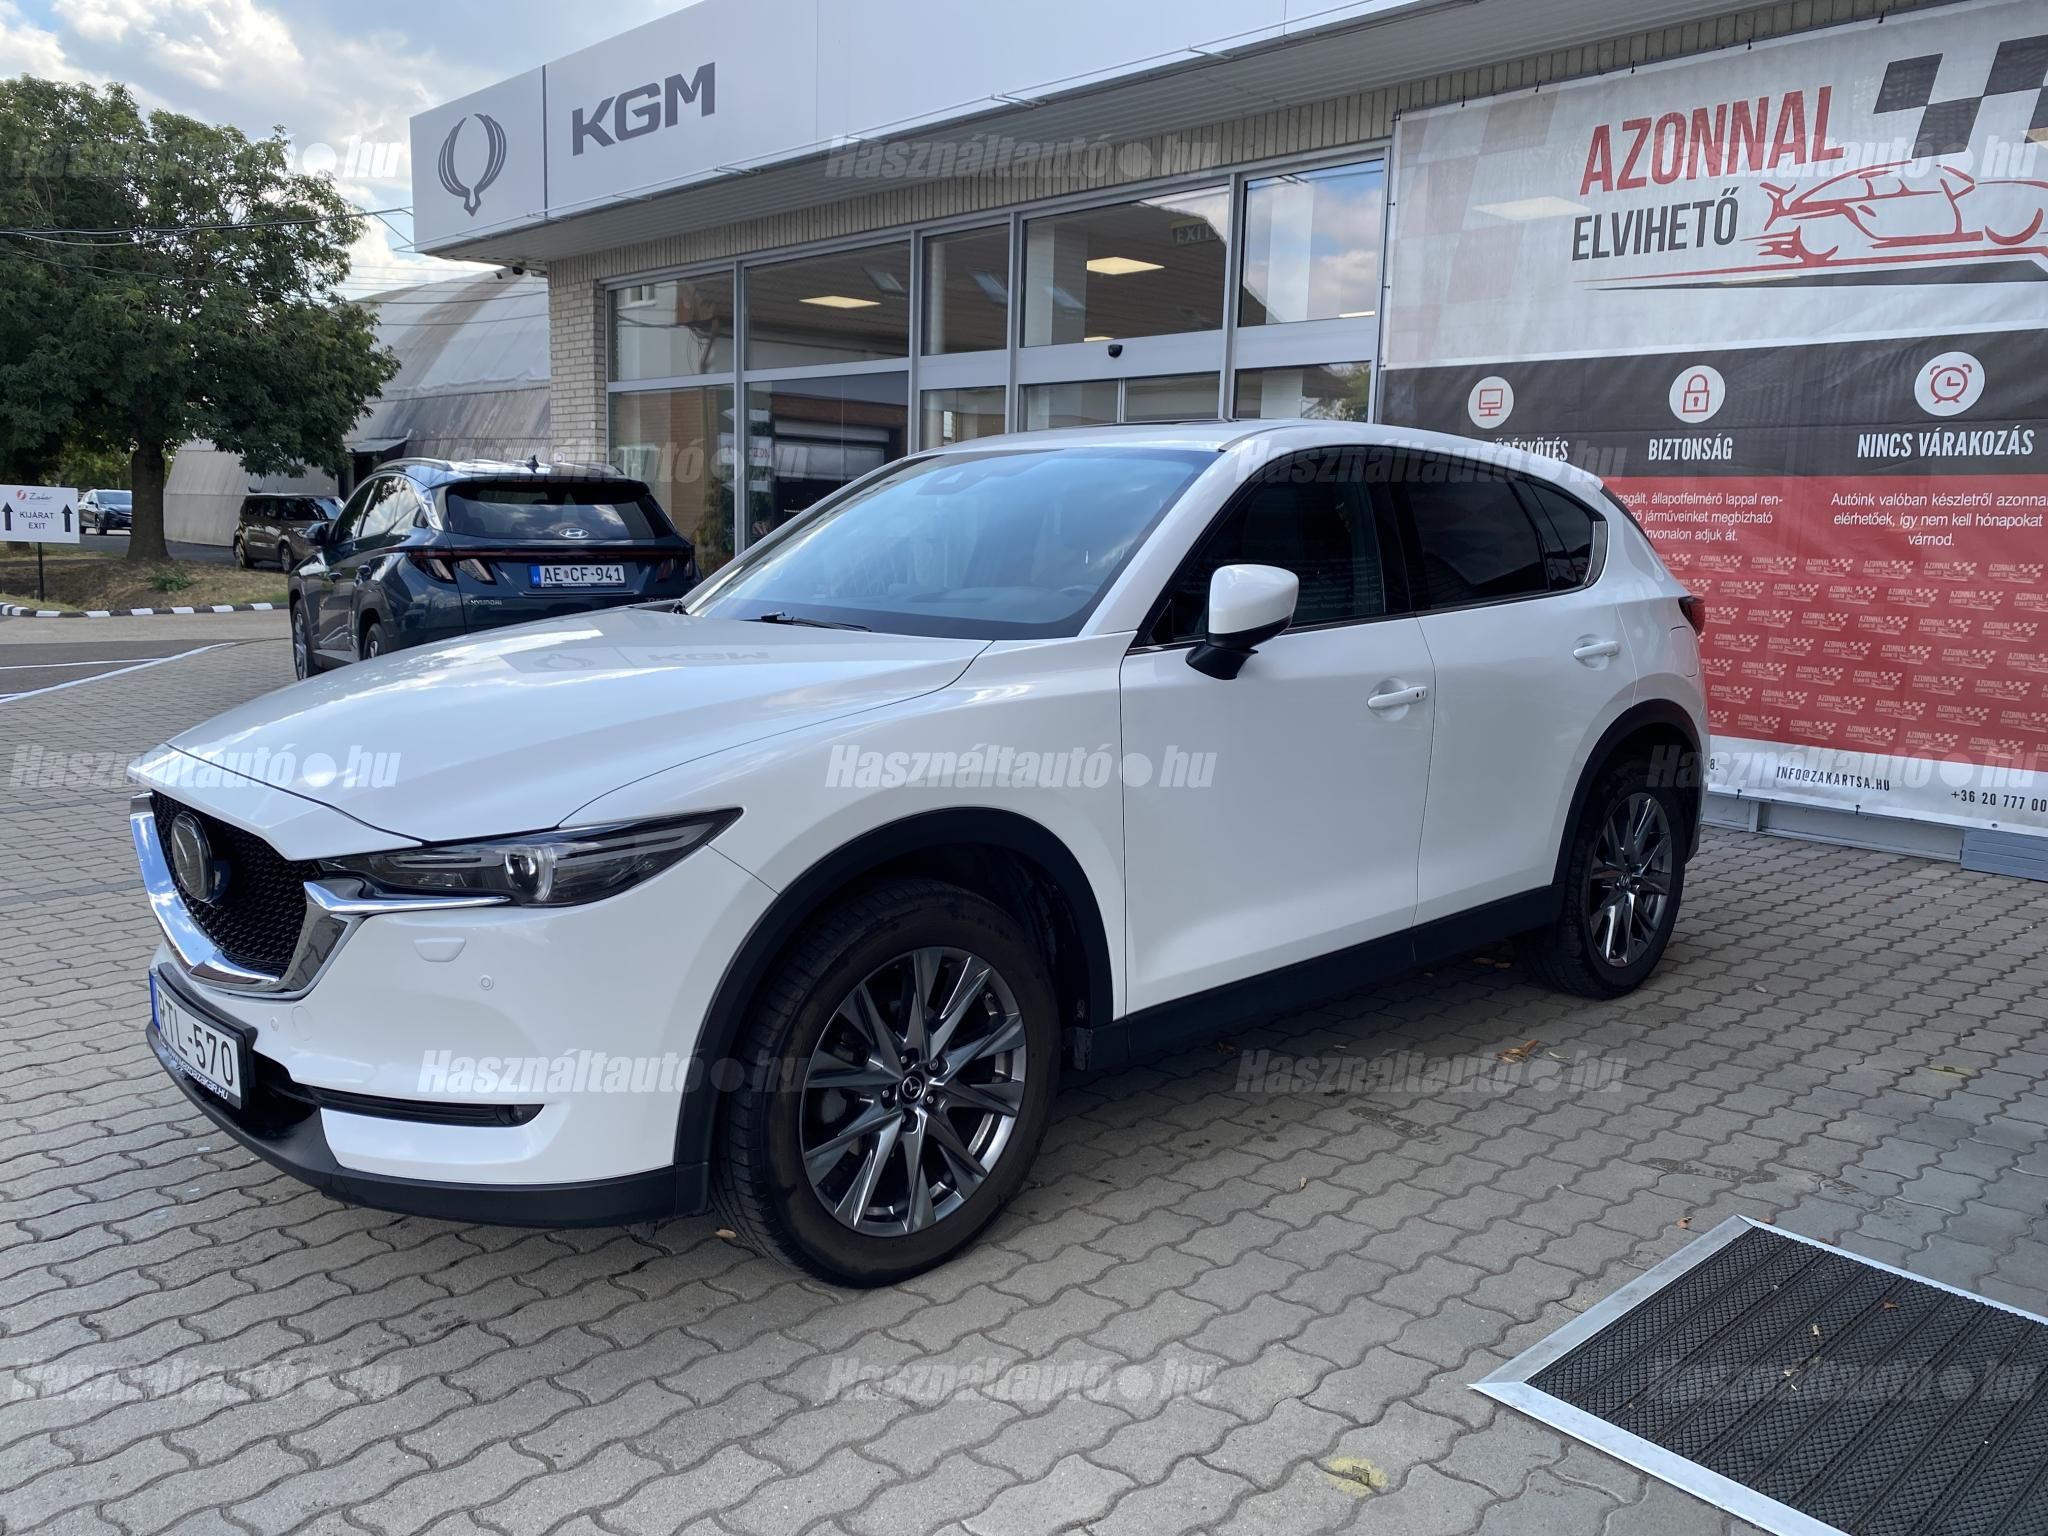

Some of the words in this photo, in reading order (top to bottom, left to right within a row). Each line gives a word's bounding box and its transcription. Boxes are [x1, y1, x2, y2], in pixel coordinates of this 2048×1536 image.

[572, 62, 715, 156] KGM
[1580, 85, 1847, 195] AZONNAL
[1573, 187, 1739, 262] ELVIHETŐ
[1648, 433, 1733, 461] BIZTONSÁG
[1857, 432, 1913, 458] NINCS
[1918, 425, 2035, 457] VÁRAKOZÁS
[1651, 492, 1722, 506] állapotfelmérő
[1726, 493, 1757, 507] lappal
[1760, 495, 1783, 505] ren-
[1831, 493, 1875, 507] Autóink
[1879, 493, 1927, 507] valóban
[1932, 493, 1992, 507] készletről
[1644, 512, 1708, 525] járműveinket
[1712, 512, 1773, 526] megbízható
[1834, 512, 1896, 527] elérhetőek,
[1899, 513, 1918, 529] így
[1921, 515, 1948, 526] nem
[1952, 513, 1972, 526] kell
[1975, 513, 2043, 529] hónapokat
[1695, 529, 1722, 543] adjuk
[1725, 529, 1738, 541] át.
[1908, 533, 1955, 546] várnod.
[544, 567, 563, 582] AE
[570, 567, 623, 581] CF-941
[1776, 765, 1890, 791] INFO@ZAKARTSA.HU
[1951, 790, 1976, 803] +36
[1982, 793, 1996, 806] 20
[2003, 795, 2025, 810] 777
[2031, 798, 2047, 812] 00
[158, 991, 234, 1087] RTL-570
